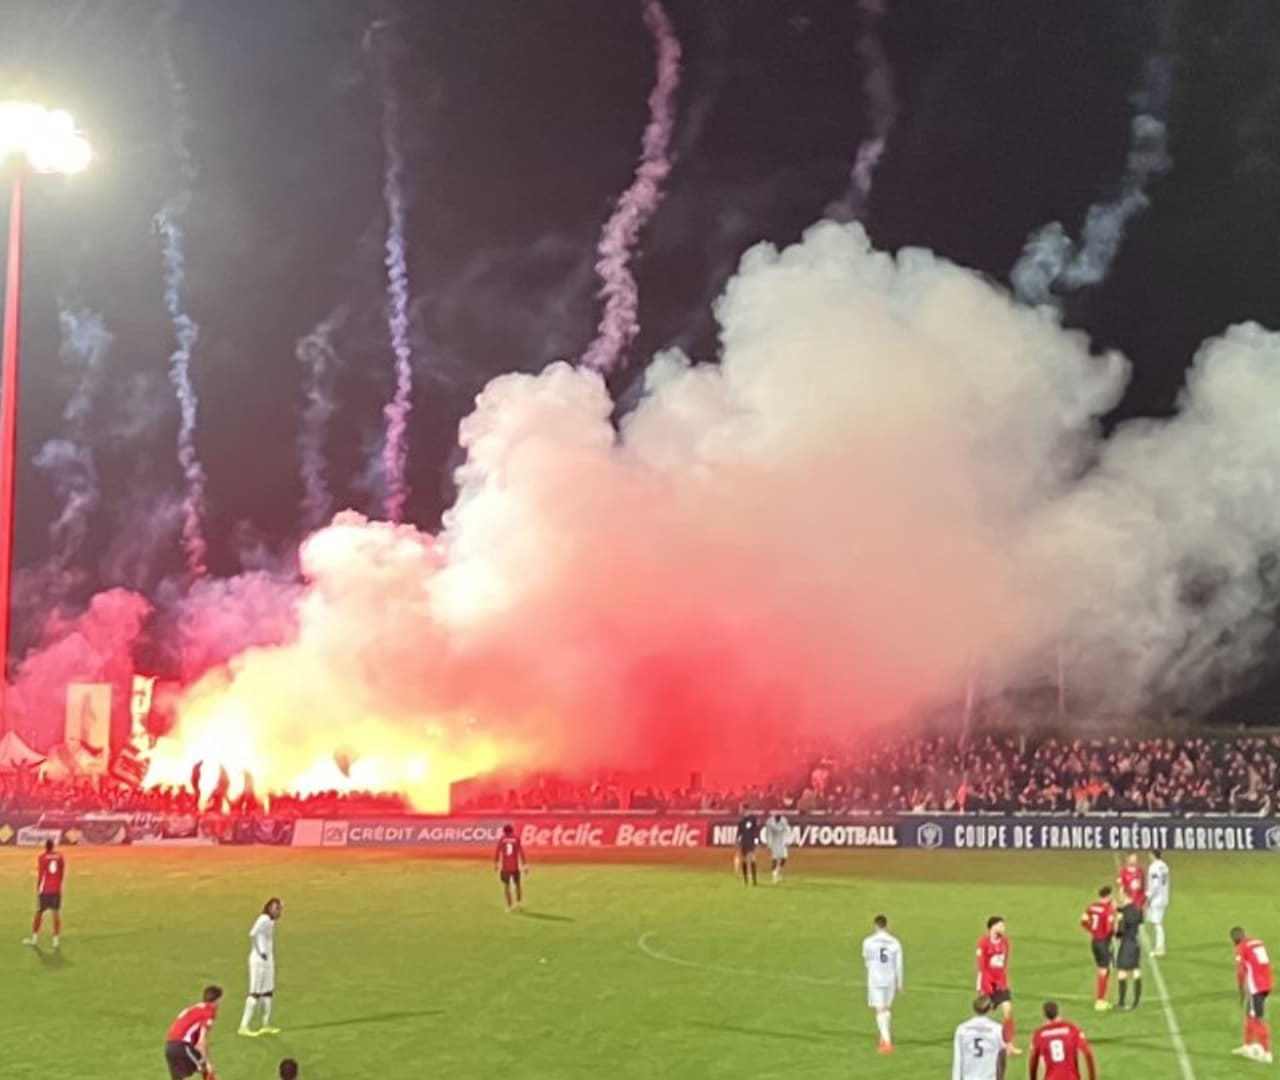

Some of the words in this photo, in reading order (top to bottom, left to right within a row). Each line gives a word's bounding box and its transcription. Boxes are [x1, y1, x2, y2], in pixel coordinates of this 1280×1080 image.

[349, 823, 411, 841] CRÉDIT
[520, 823, 602, 846] Betclic
[616, 824, 699, 846] Betclic
[955, 825, 1007, 848] COUPE
[1013, 825, 1033, 848] DE
[1040, 825, 1102, 848] FRANCE
[1108, 822, 1166, 849] CRÉDIT
[1172, 826, 1252, 849] AGRICOLE
[973, 1038, 984, 1058] 5
